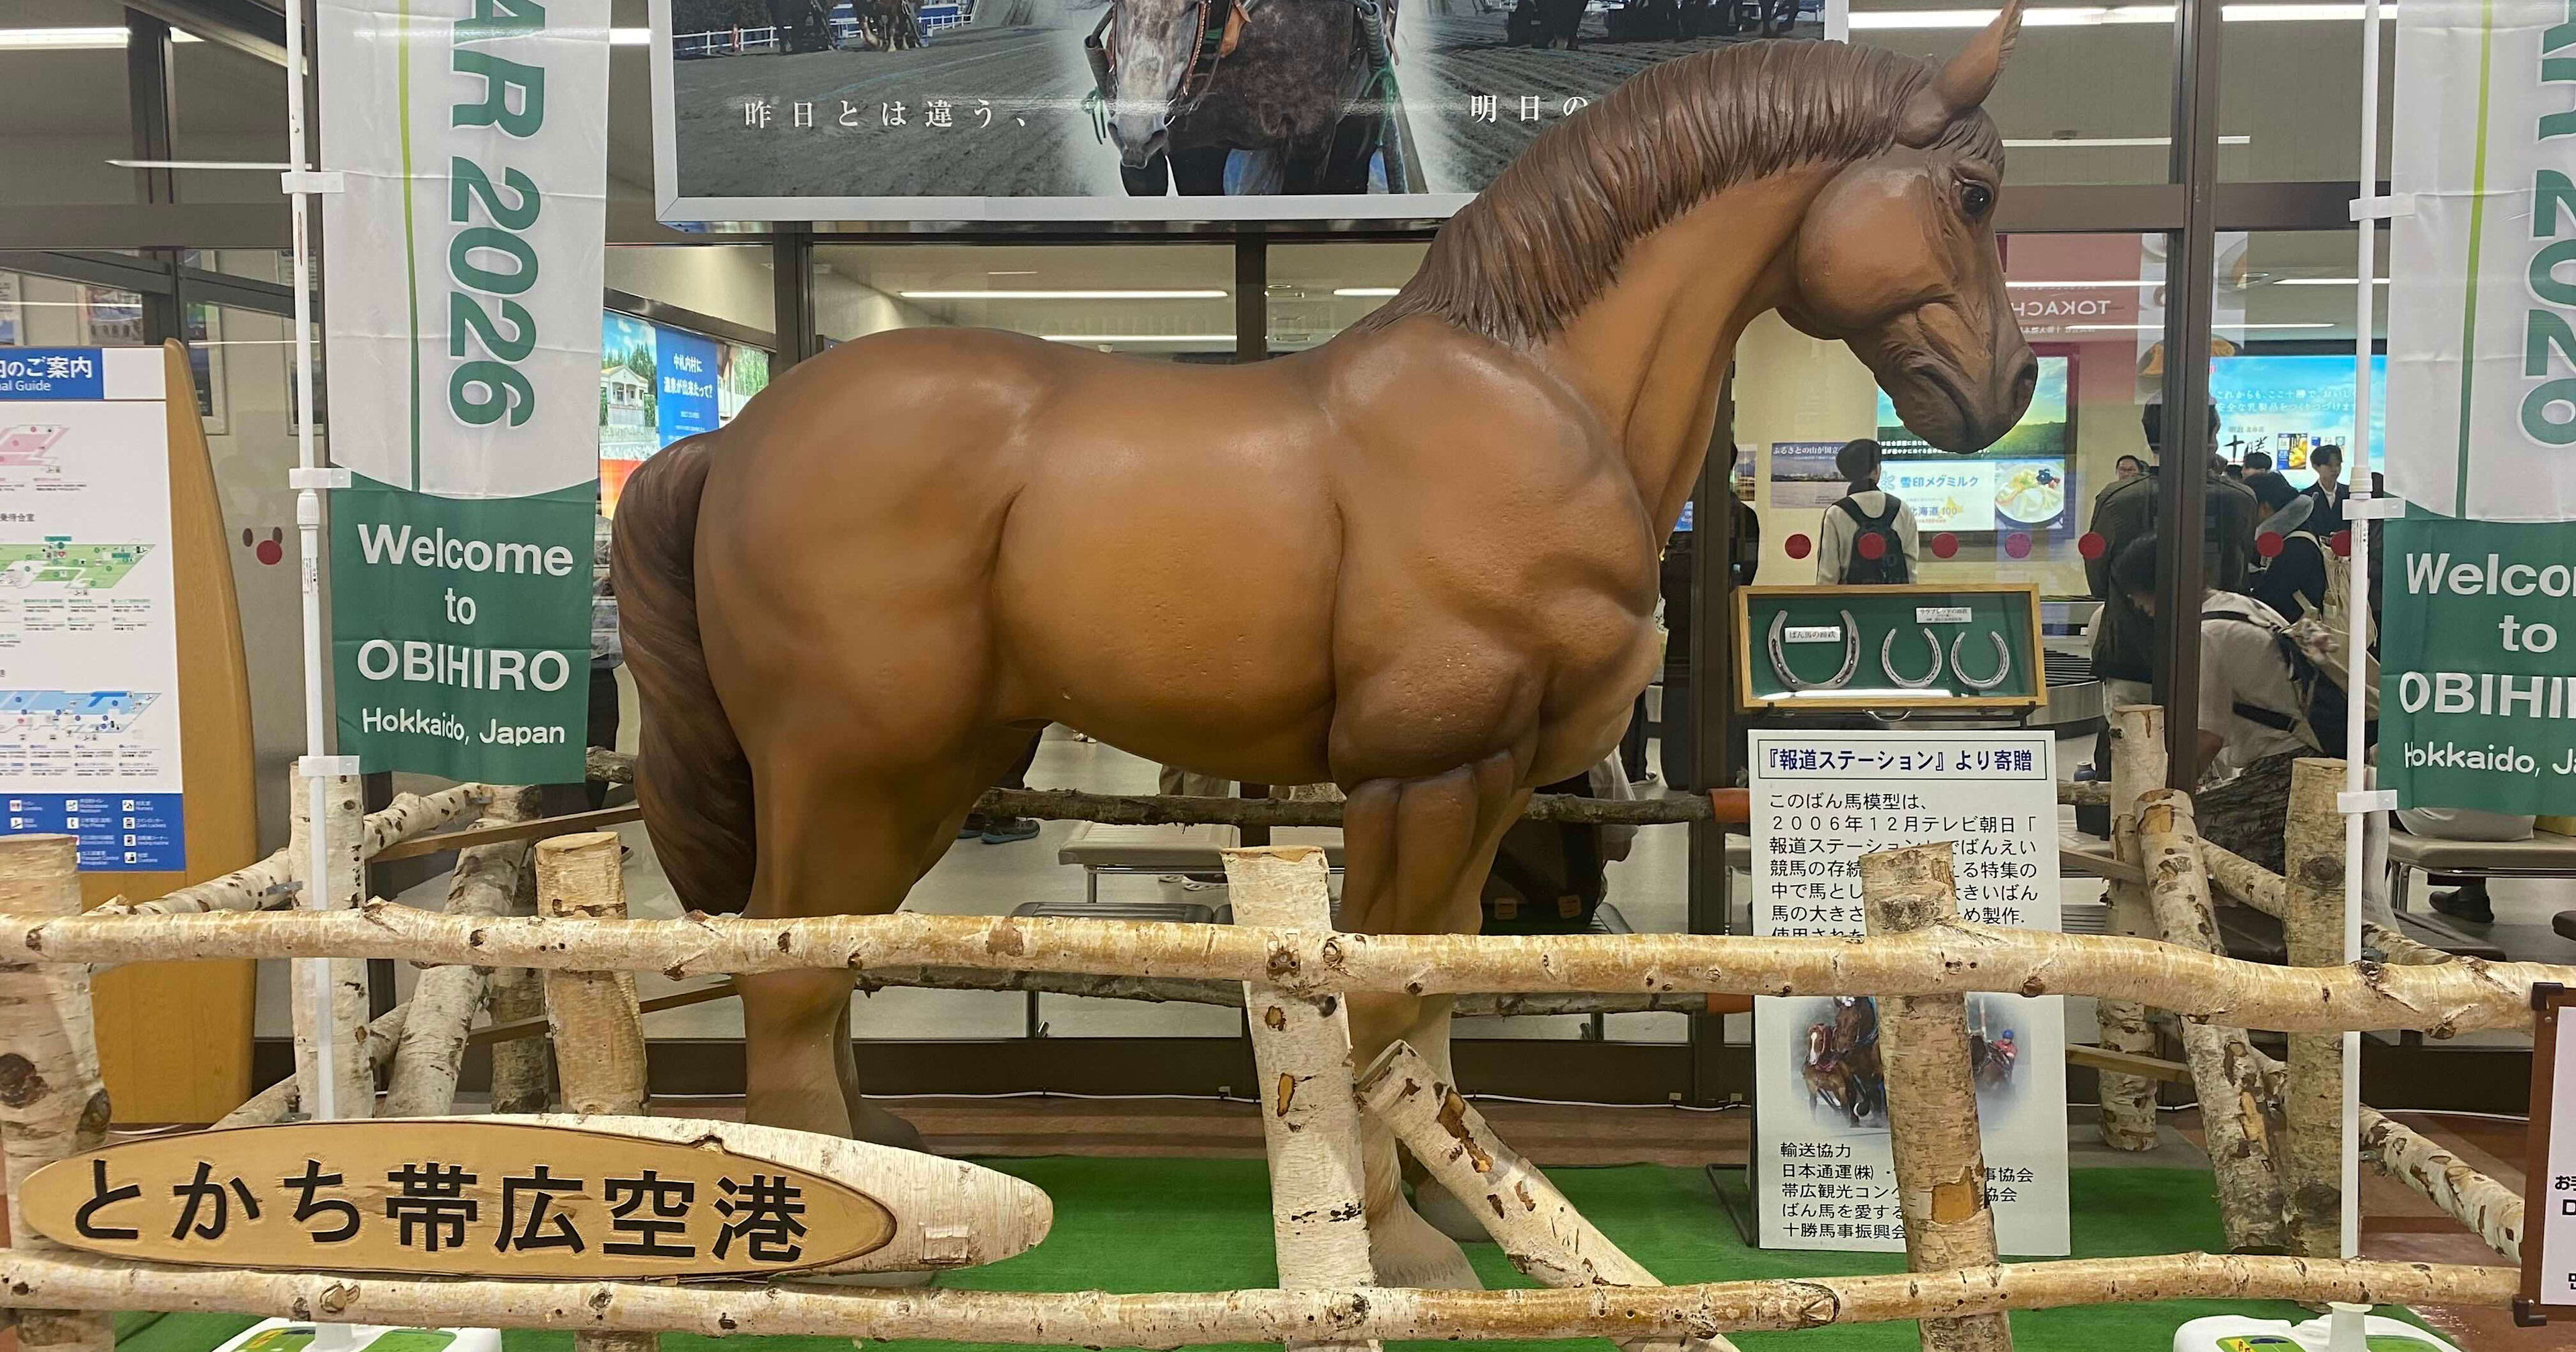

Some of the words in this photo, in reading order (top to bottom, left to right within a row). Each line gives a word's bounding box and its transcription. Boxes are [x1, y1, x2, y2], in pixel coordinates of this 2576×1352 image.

[744, 99, 1029, 129] 昨日とは違う、
[1470, 95, 1589, 123] 明日の
[447, 155, 541, 430] 2026
[15, 380, 52, 391] Guide
[2216, 402, 2356, 412] 安全な乳製品をつくりつづけま
[1900, 475, 1979, 488] 雪印メグミルク
[358, 524, 574, 577] Welcome
[2406, 553, 2576, 598] Welco
[444, 587, 476, 624] to
[2498, 614, 2558, 653] to
[358, 639, 570, 692] OBIHIRO
[362, 707, 470, 746] Hokkaido,
[479, 718, 565, 747] Japan
[1769, 748, 2033, 773] 『報道ステーション』より寄贈
[2404, 741, 2540, 778] Hokkaido,
[2552, 748, 2576, 775] J
[1769, 792, 1928, 811] このばん馬模型は、
[1780, 1142, 1851, 1159] 輸送協力
[74, 1159, 810, 1263] とかち帯広空港
[1782, 1202, 1904, 1220] ばん馬を愛する
[1782, 1223, 1907, 1240] 十勝馬事振興会
